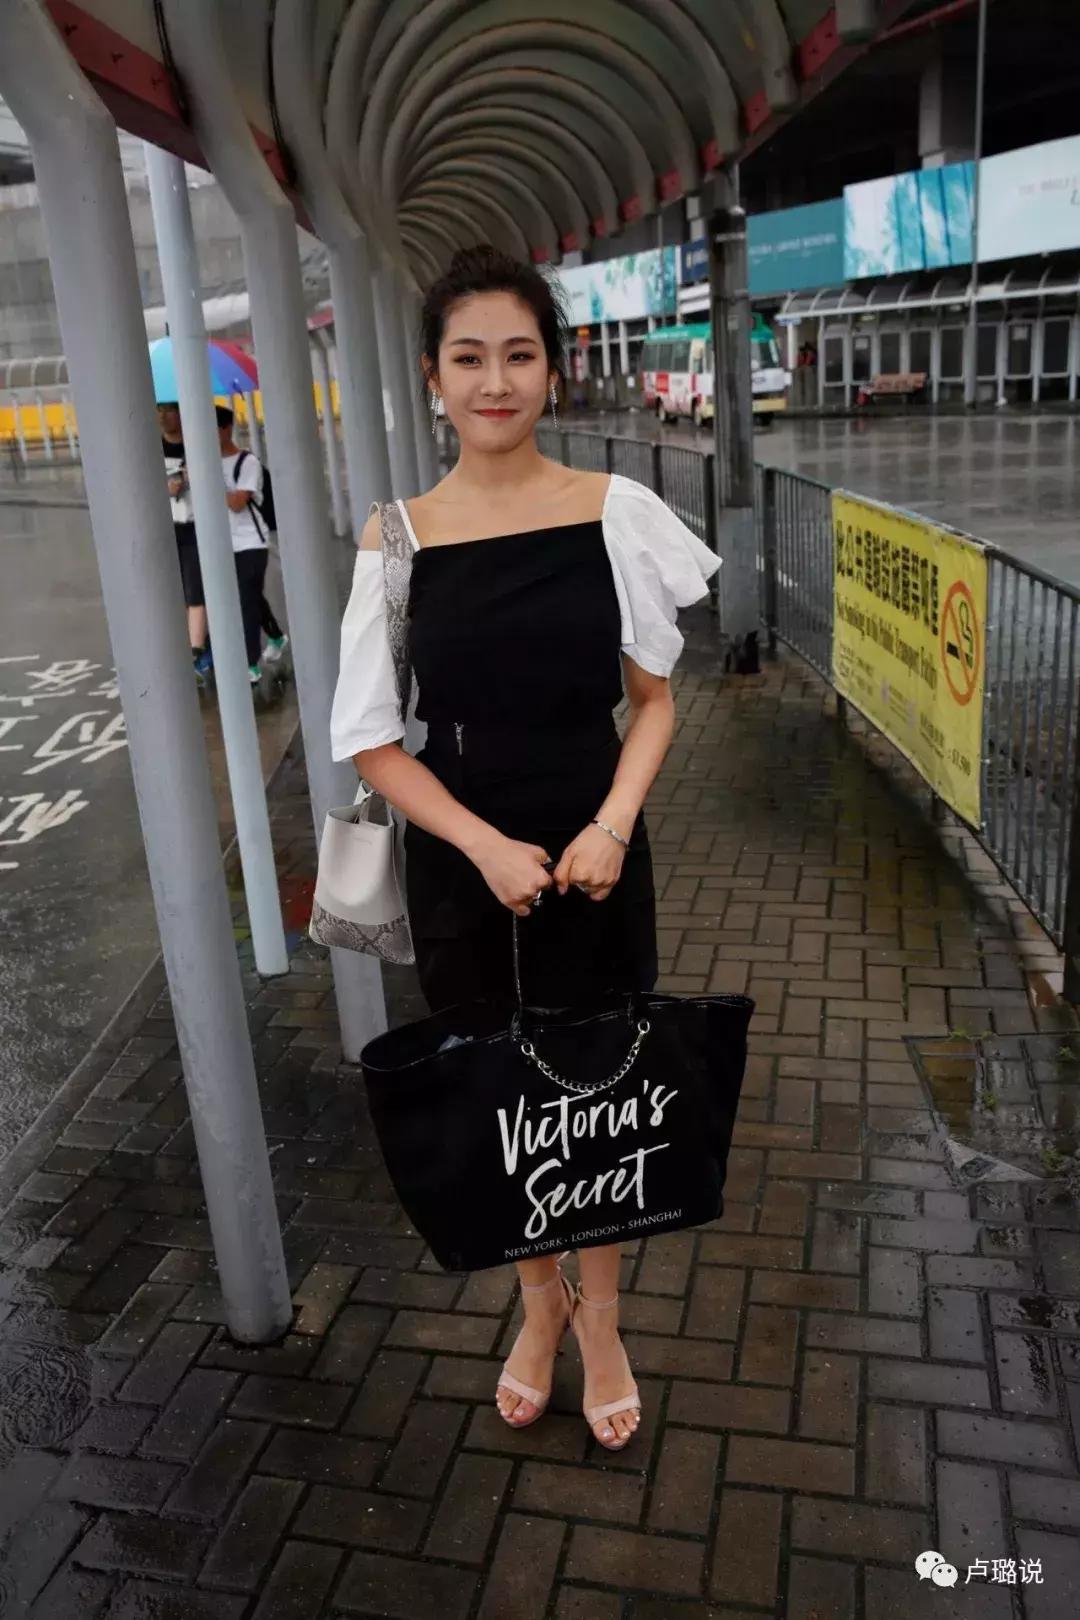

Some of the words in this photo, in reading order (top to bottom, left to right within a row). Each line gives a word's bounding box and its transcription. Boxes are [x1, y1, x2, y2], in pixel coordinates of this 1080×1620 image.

[497, 1080, 679, 1176] Victoria's
[504, 1245, 531, 1259] NEW
[534, 1237, 563, 1253] YORK
[571, 1223, 620, 1243] LONDON
[628, 1209, 682, 1230] SHANGHAI
[524, 1143, 670, 1240] Secret
